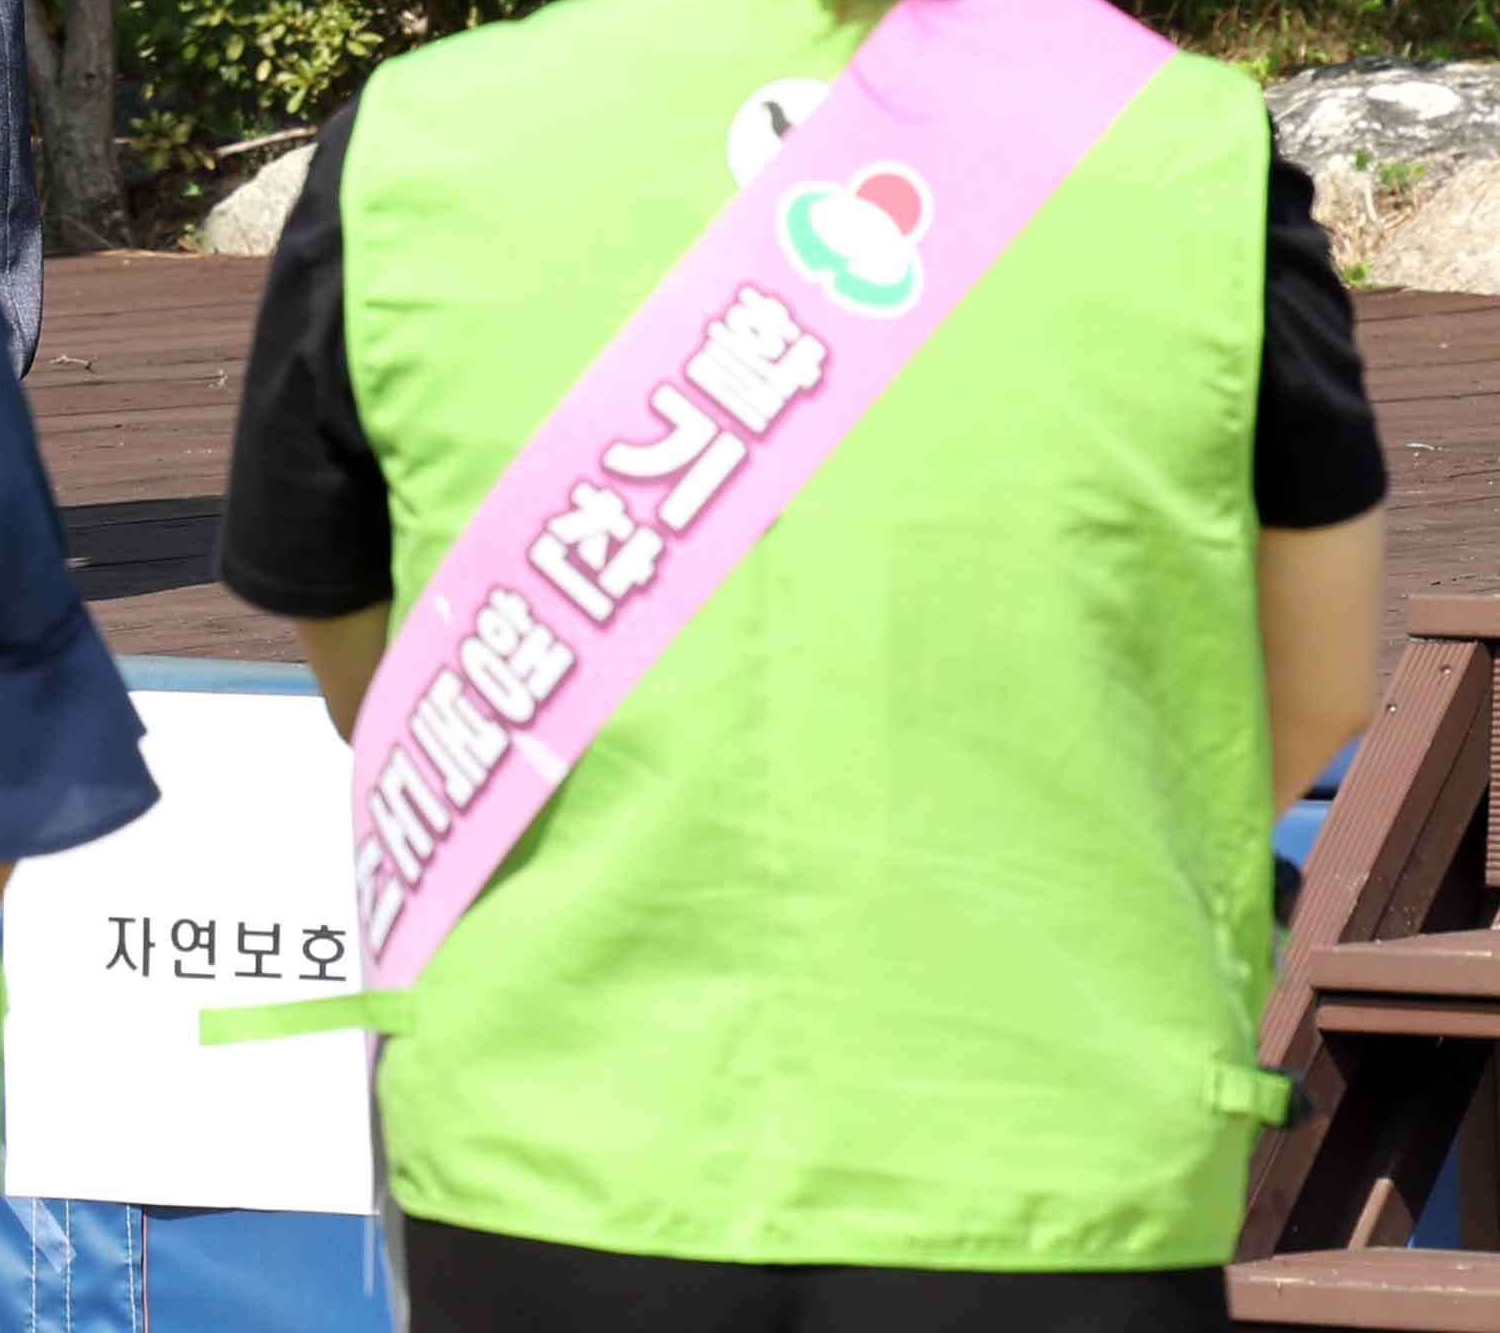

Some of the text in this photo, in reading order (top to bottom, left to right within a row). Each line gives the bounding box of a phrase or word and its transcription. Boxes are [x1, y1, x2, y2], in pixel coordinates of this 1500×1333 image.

[357, 284, 830, 965] 활기찬 행복도시
[105, 915, 347, 982] 자연보호
